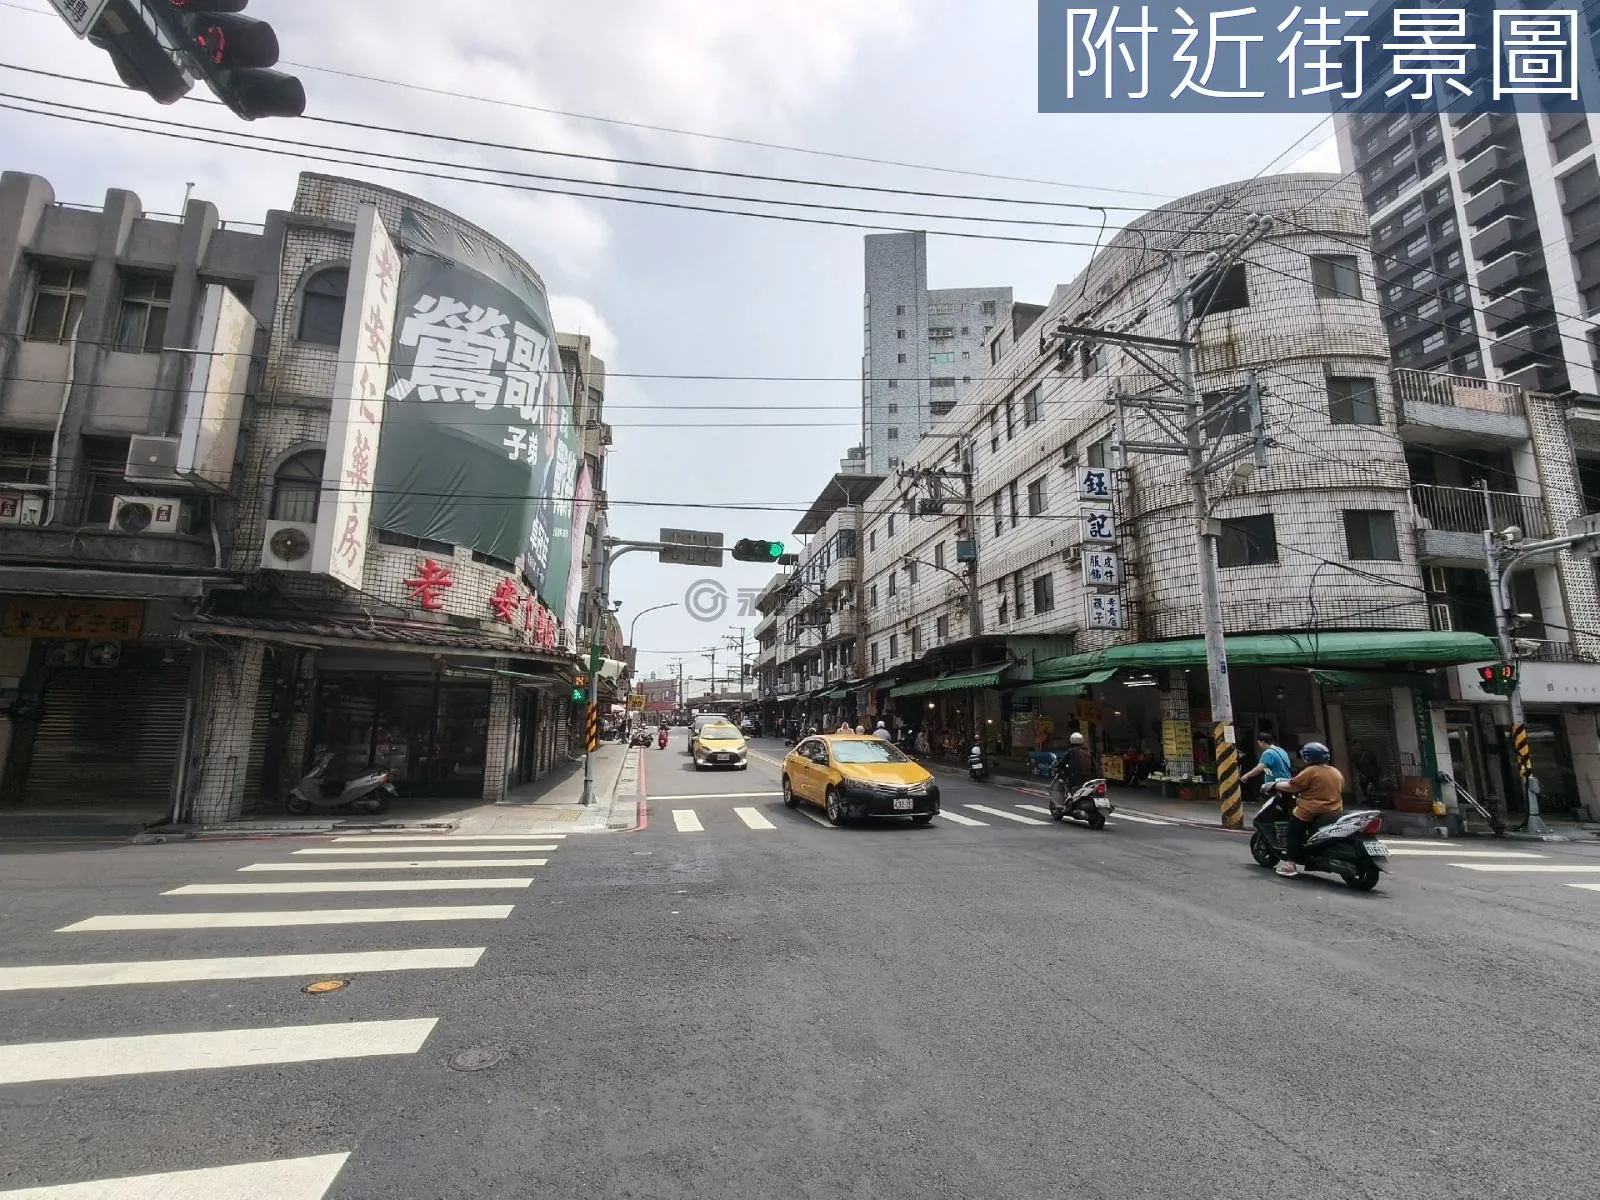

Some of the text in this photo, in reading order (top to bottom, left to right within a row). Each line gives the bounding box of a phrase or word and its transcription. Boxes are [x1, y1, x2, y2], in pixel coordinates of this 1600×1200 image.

[386, 294, 551, 430] 鶯歌
[336, 241, 396, 569] 老安仁藥房
[503, 425, 538, 466] 子弟
[1083, 470, 1112, 538] 鈺記
[1089, 555, 1102, 580] 服飾
[1104, 556, 1116, 582] 皮件
